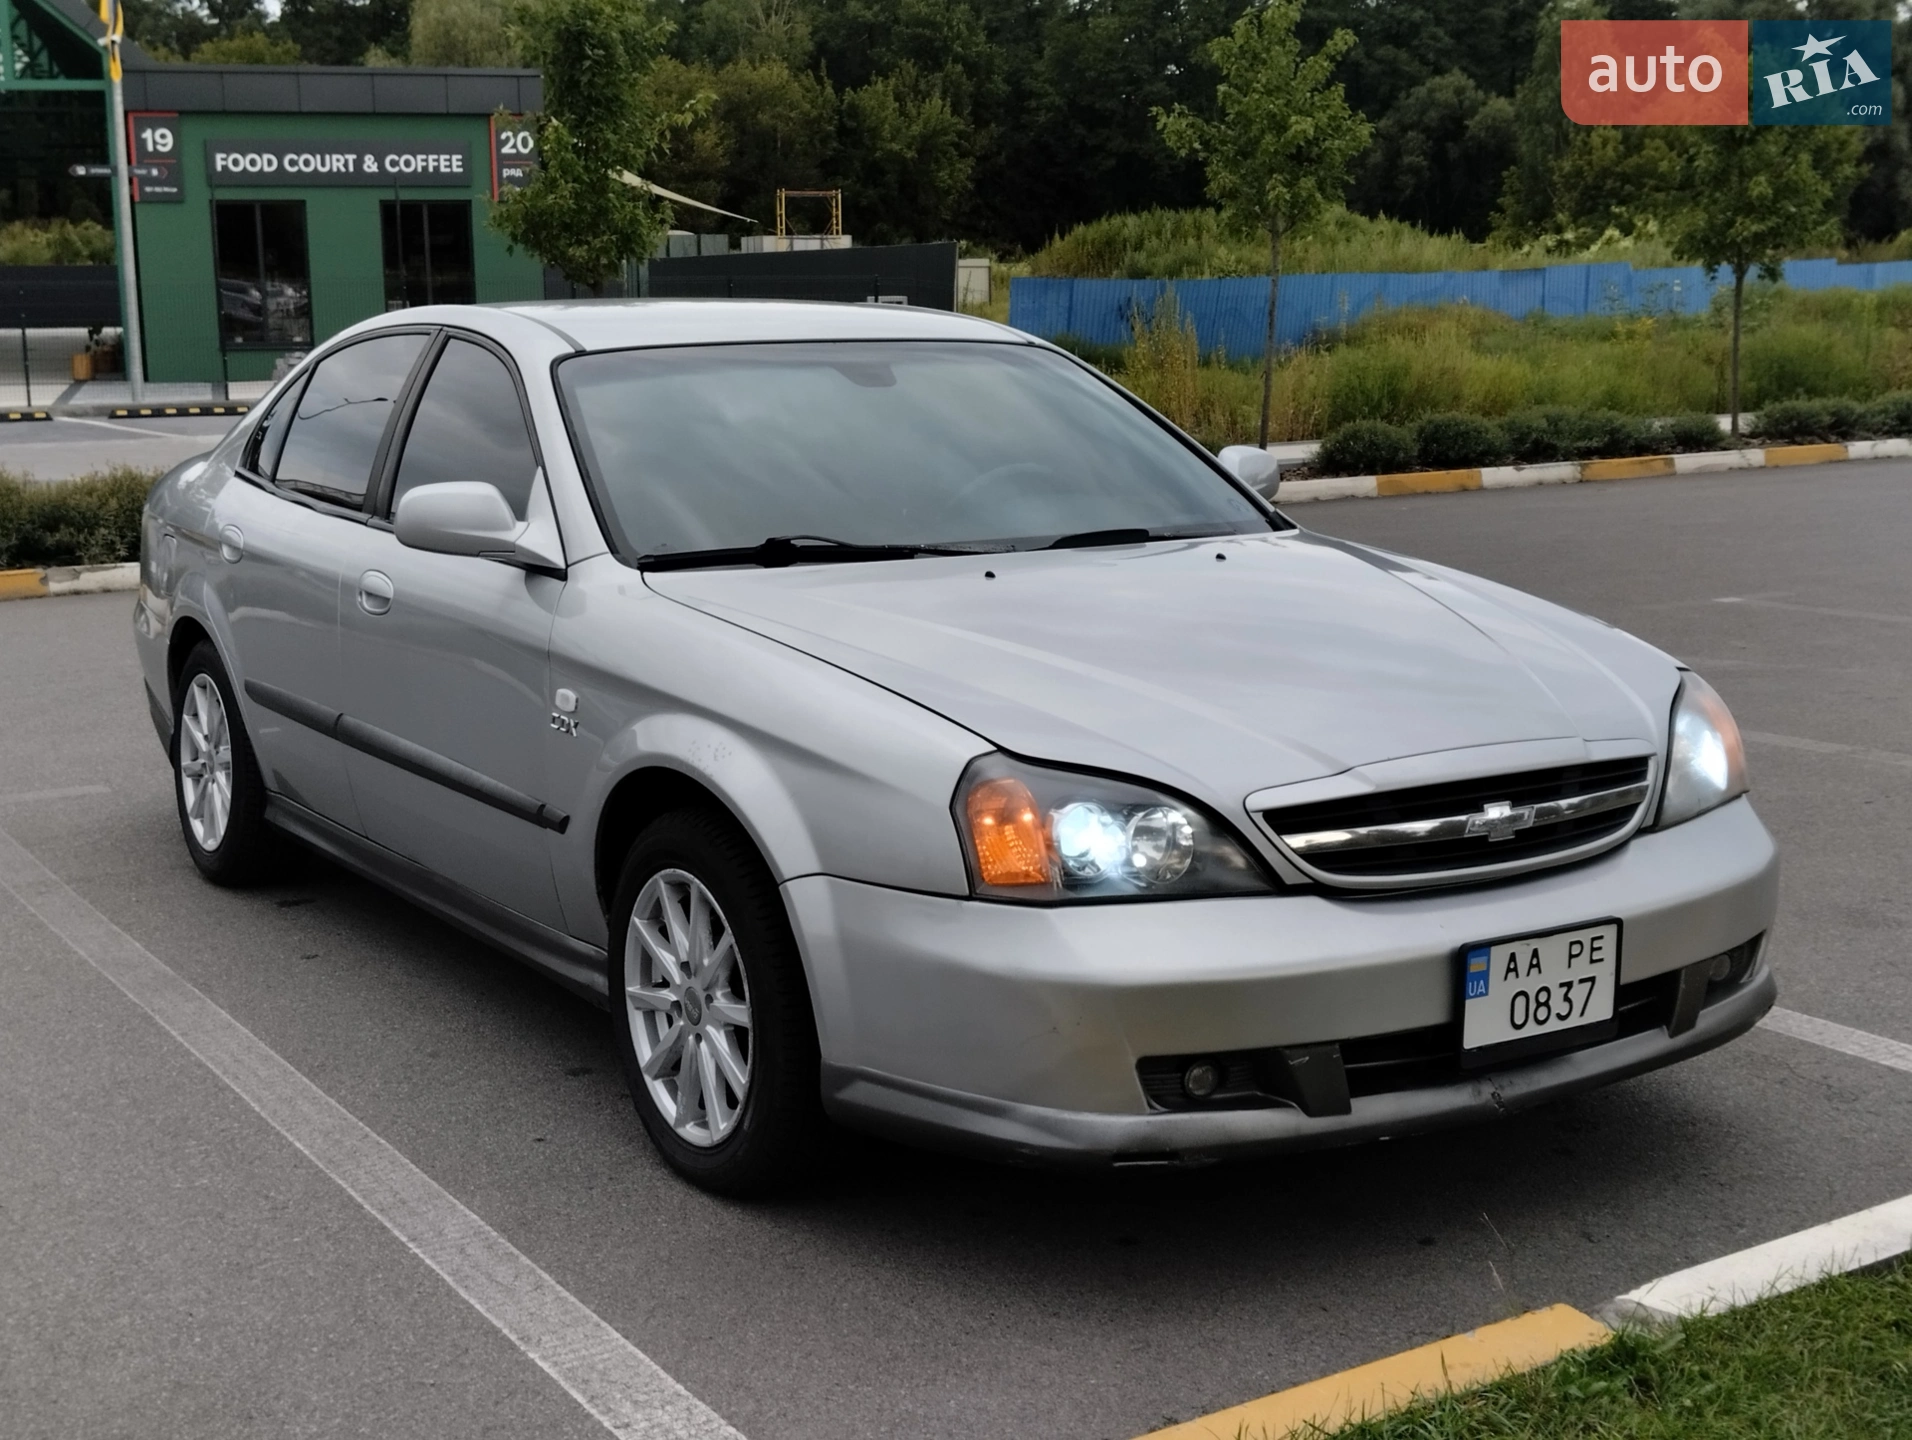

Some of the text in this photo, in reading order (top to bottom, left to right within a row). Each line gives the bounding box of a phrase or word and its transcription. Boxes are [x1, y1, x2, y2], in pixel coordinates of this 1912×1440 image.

[141, 127, 174, 153] 19
[500, 130, 534, 154] 20
[215, 152, 464, 173] FOOD COURT & COFFEE
[1503, 935, 1605, 982] AA PE
[1468, 979, 1486, 997] UA
[1510, 975, 1597, 1031] 0837
